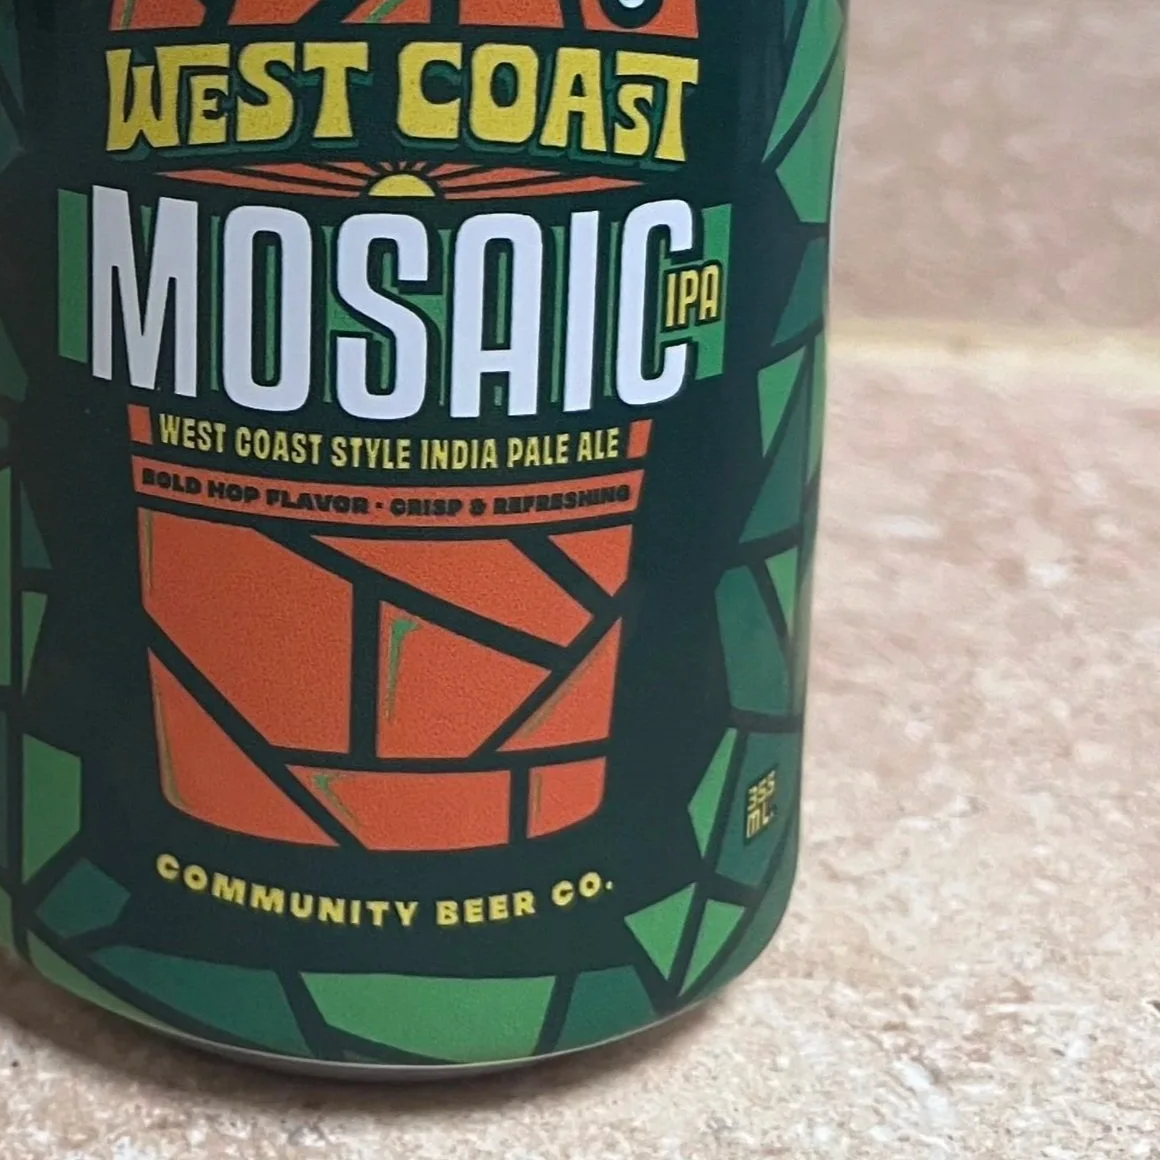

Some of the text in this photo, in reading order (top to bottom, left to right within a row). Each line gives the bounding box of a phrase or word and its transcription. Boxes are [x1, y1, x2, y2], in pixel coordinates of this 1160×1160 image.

[105, 42, 699, 162] WEST COAST
[91, 184, 693, 420] MOSAIC
[666, 264, 722, 328] IPA
[159, 413, 621, 470] WEST COAST STYLE INDIA PALE ALE
[141, 467, 203, 494] BOLD
[207, 480, 261, 503] HOP
[266, 489, 369, 515] FLAVOR
[389, 498, 463, 517] CRISP
[493, 484, 631, 516] REFRESHING
[156, 853, 615, 927] COMMUNITY BEER CO.
